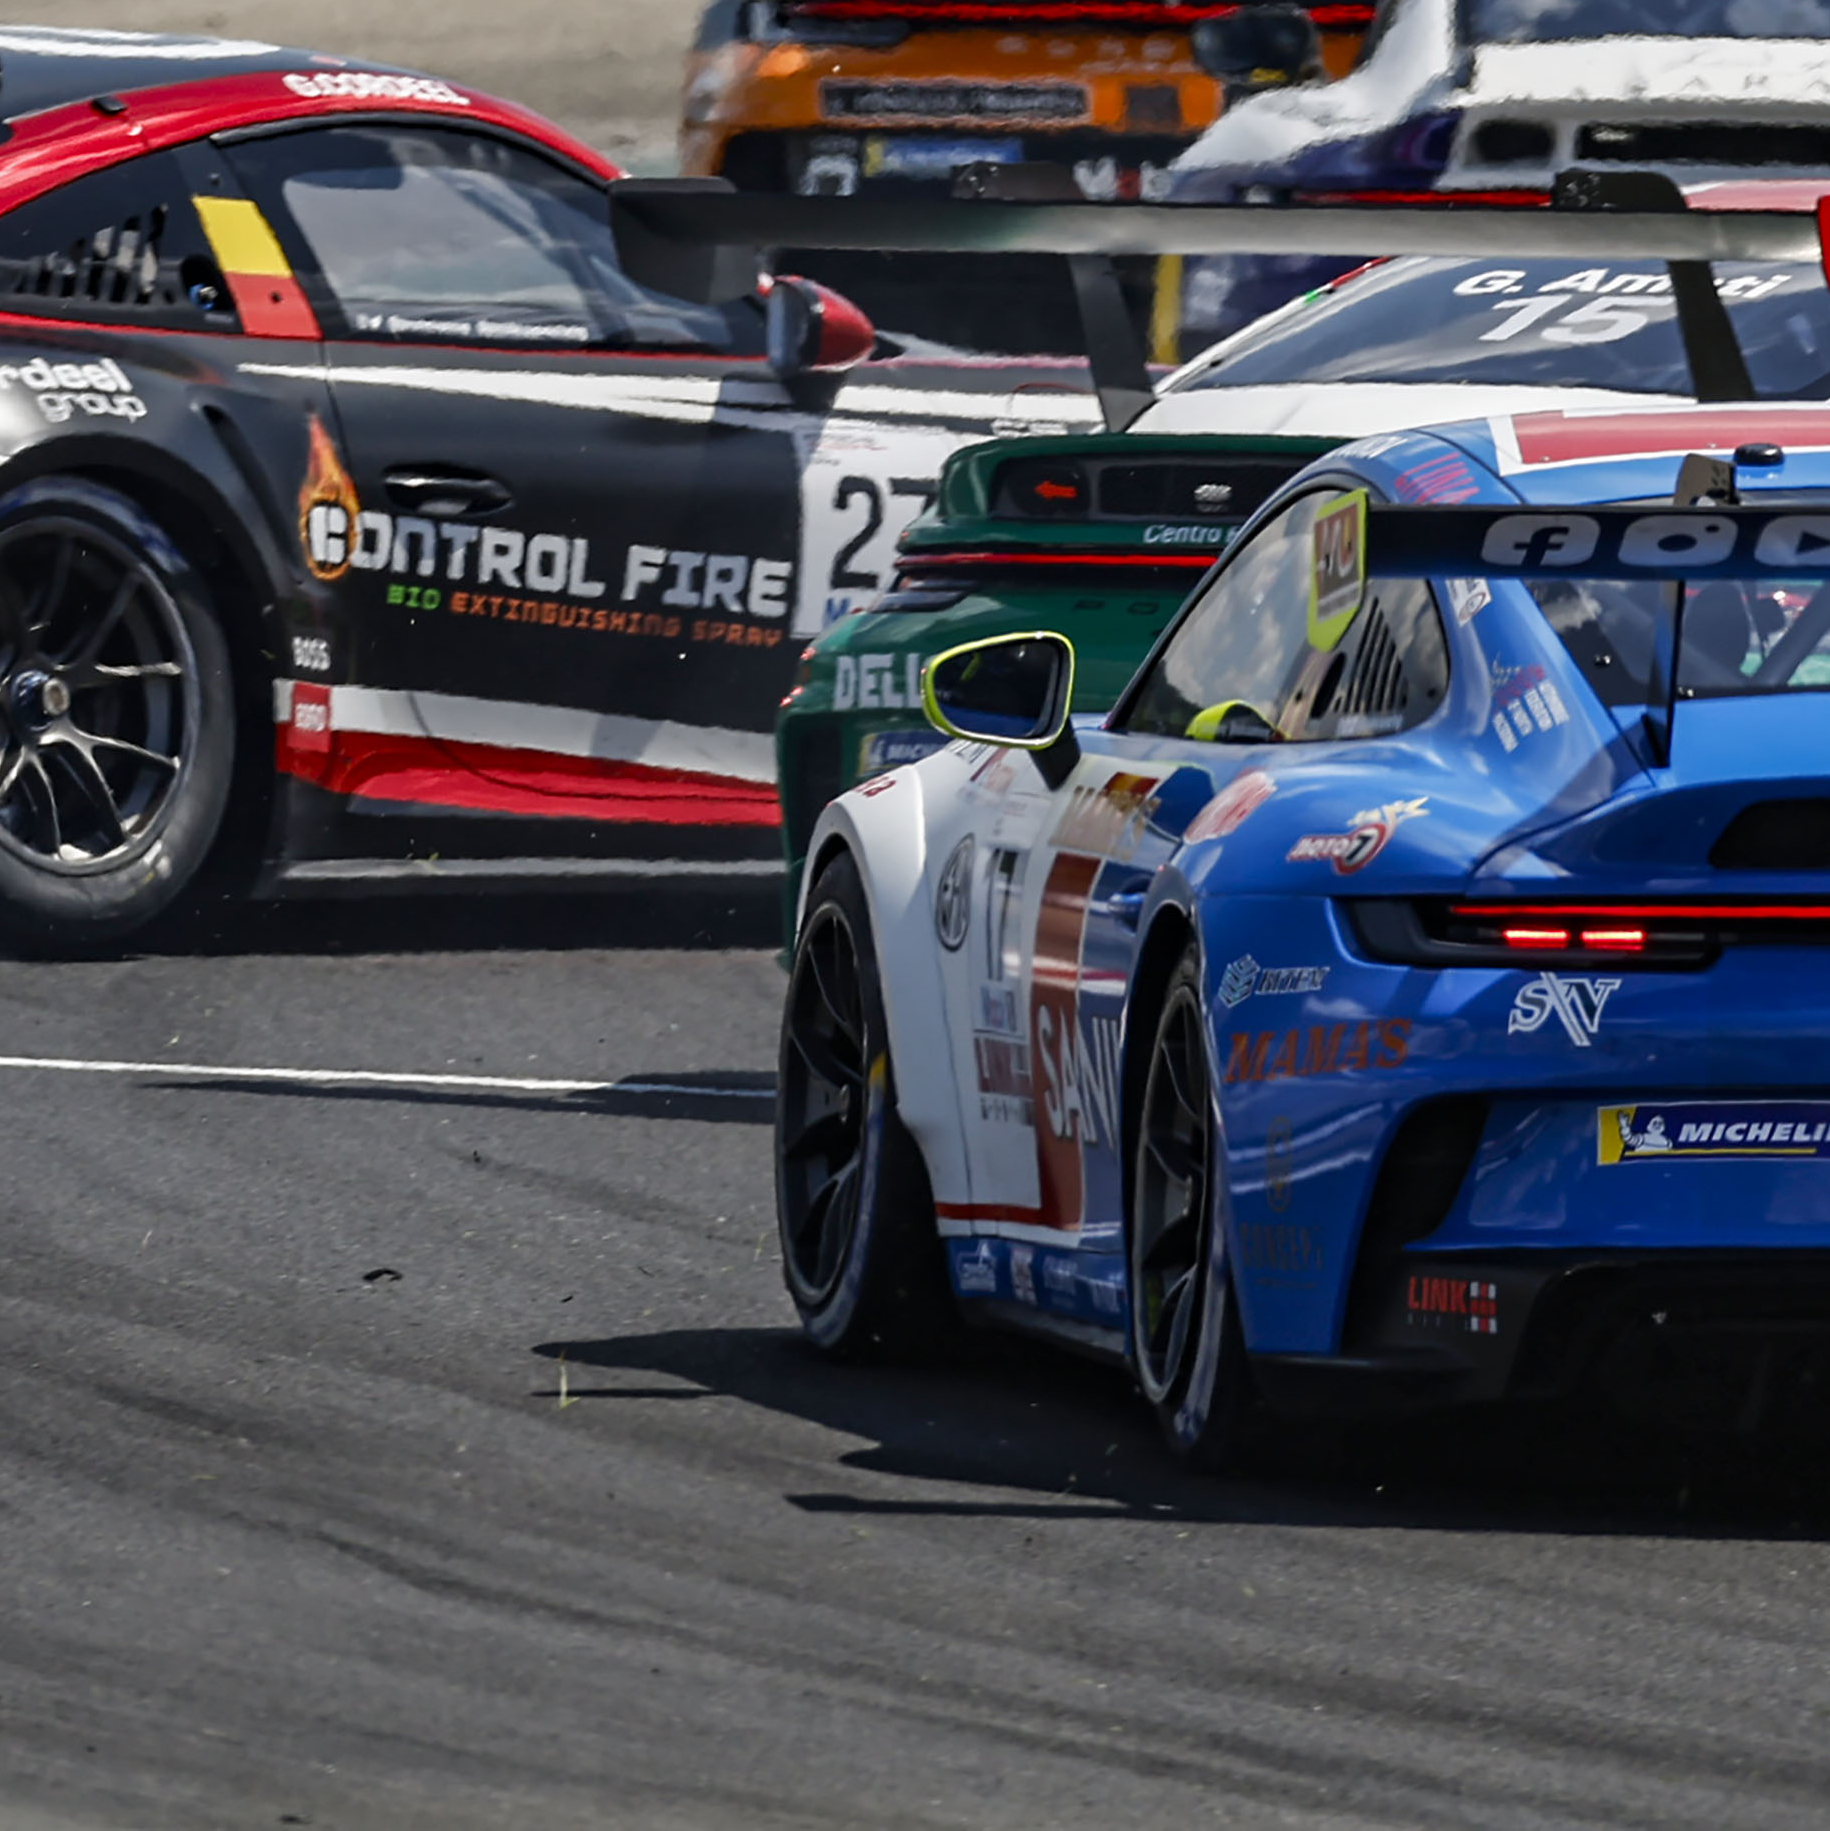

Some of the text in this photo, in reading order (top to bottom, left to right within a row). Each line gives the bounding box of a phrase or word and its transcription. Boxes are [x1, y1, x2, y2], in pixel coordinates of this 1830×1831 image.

[1453, 268, 1792, 298] G. Amti
[1478, 294, 1677, 344] 15
[37, 392, 147, 423] group
[1143, 524, 1222, 544] Centro
[309, 506, 792, 618] CONTROL FIRE
[386, 583, 783, 648] BIO EXTINGUISHING SPRAY
[1408, 1275, 1467, 1313] LINK
